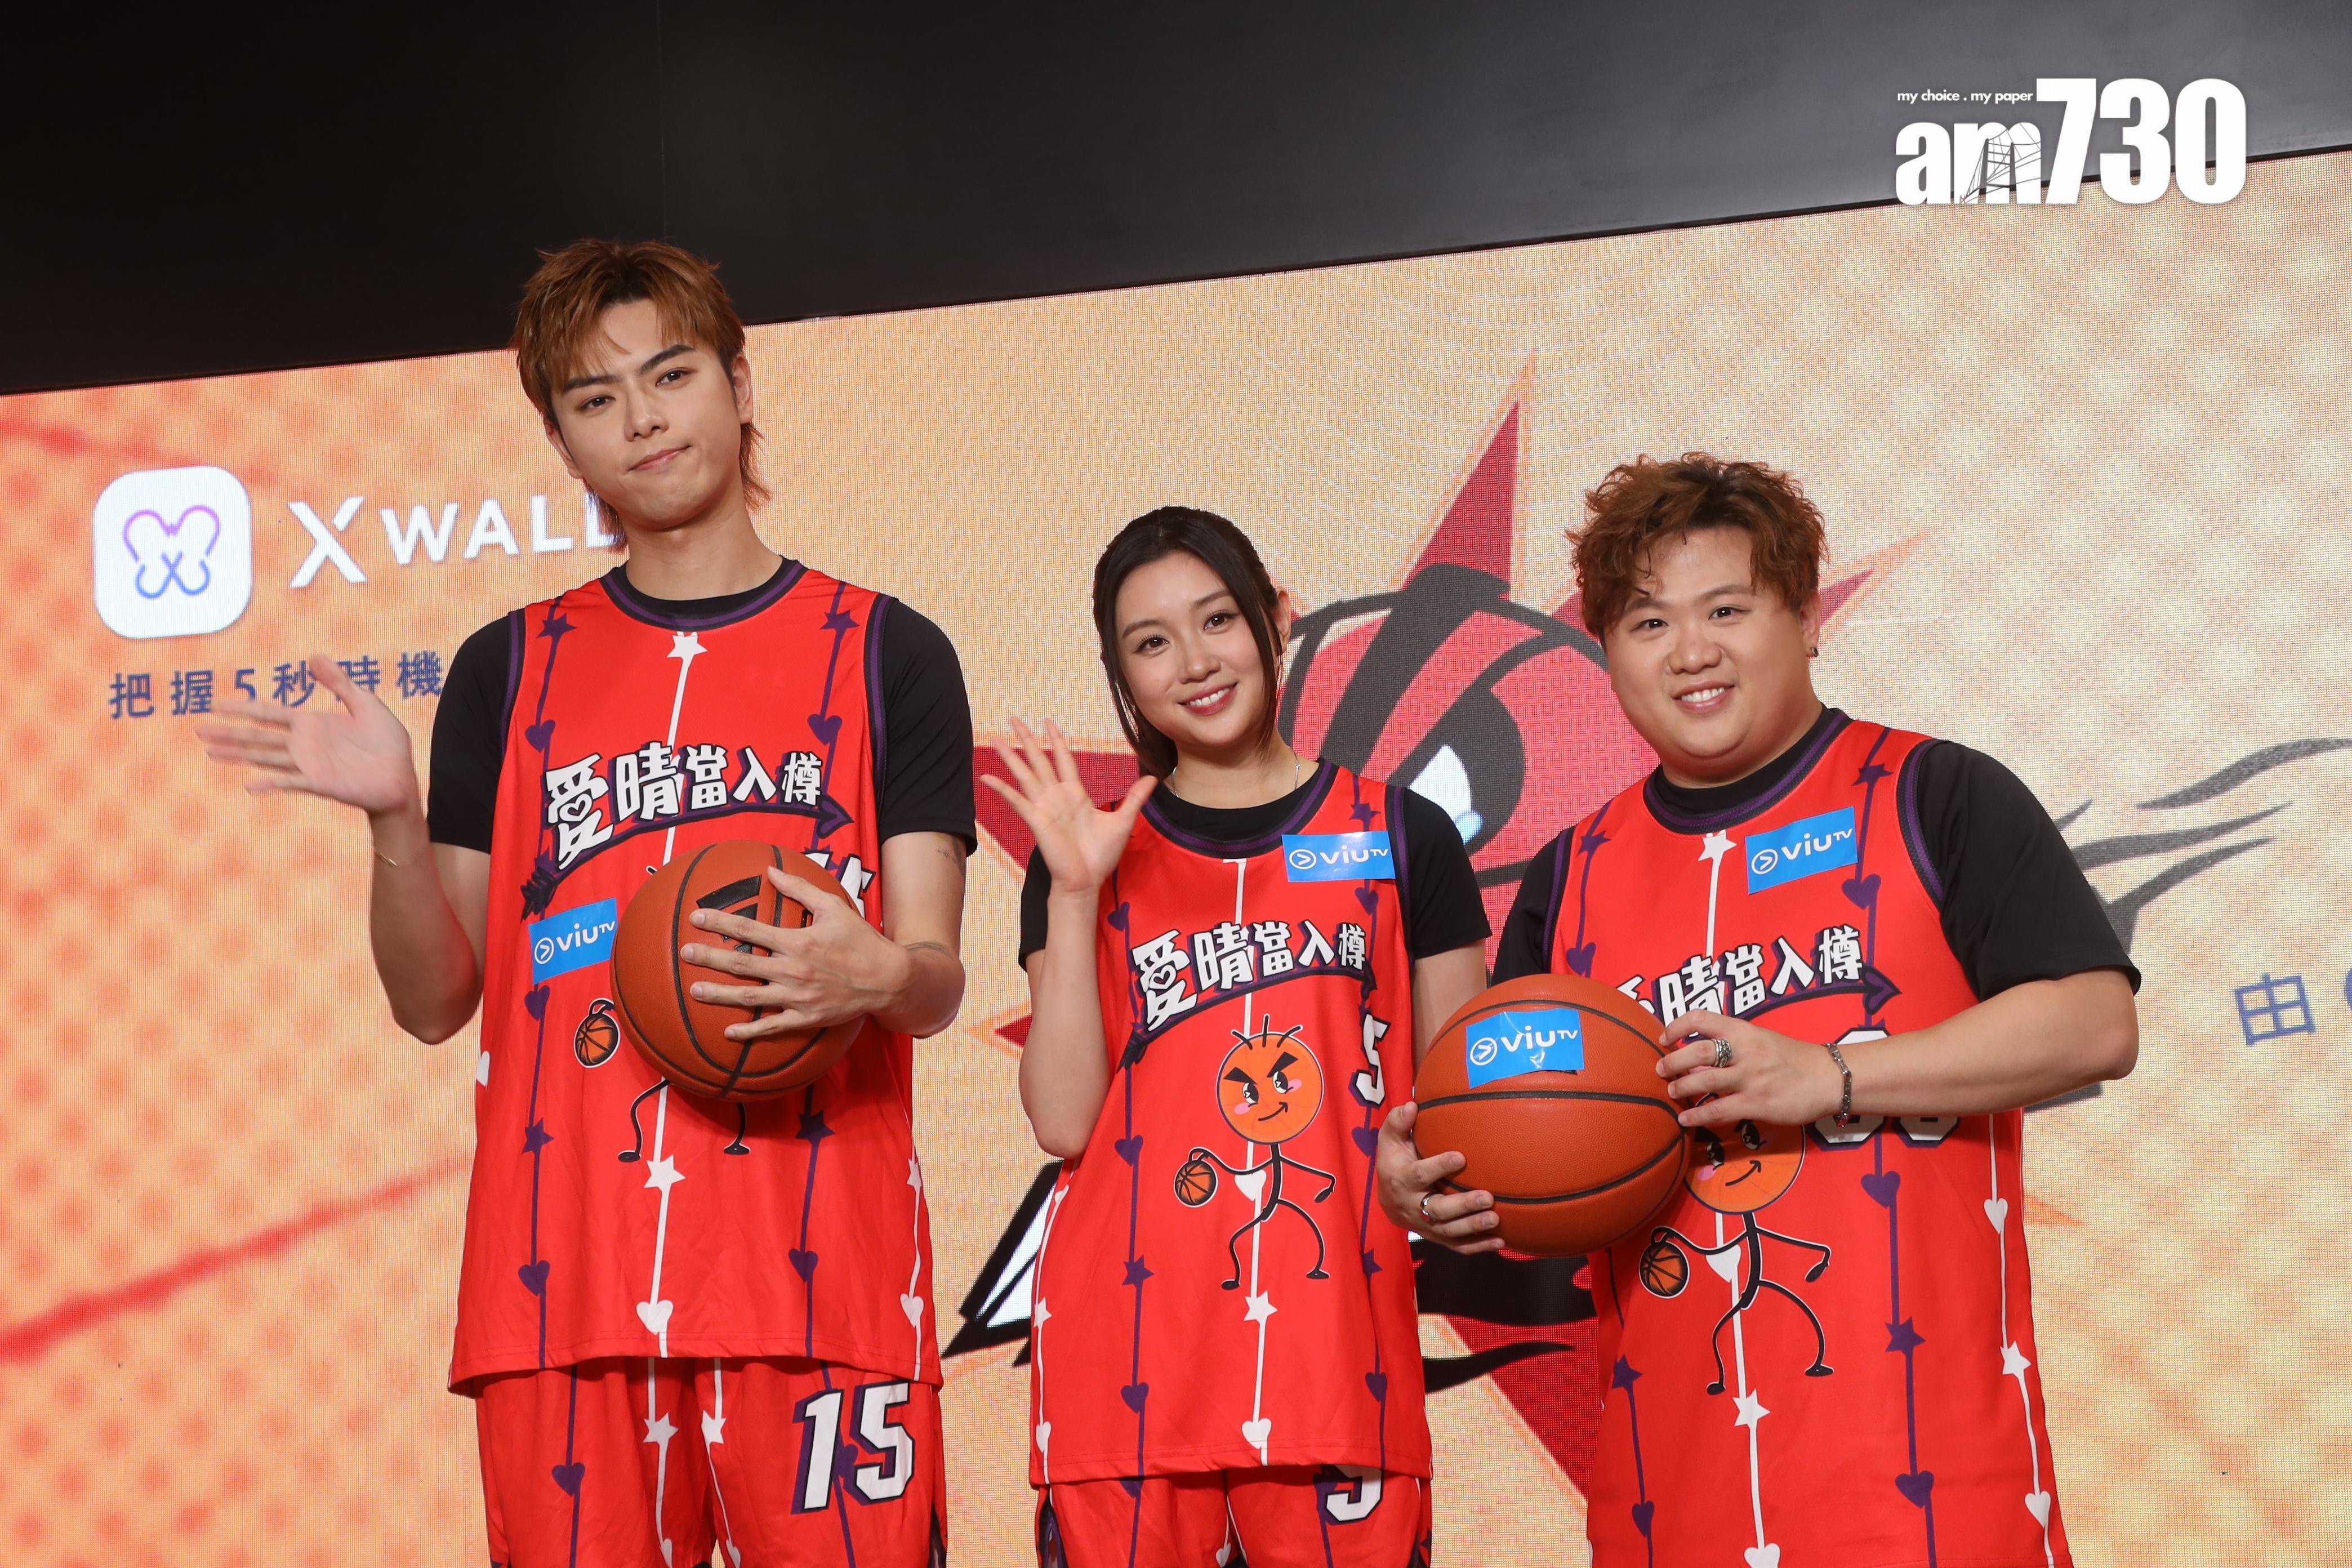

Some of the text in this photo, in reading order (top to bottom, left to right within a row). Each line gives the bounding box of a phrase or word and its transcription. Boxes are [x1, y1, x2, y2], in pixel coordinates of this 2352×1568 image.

[544, 740, 823, 871] 愛晴當入樽
[1132, 919, 1366, 1032] 愛晴當入樽
[2234, 972, 2317, 1046] 由
[1355, 1014, 1391, 1105] 5
[803, 1382, 914, 1509] 15
